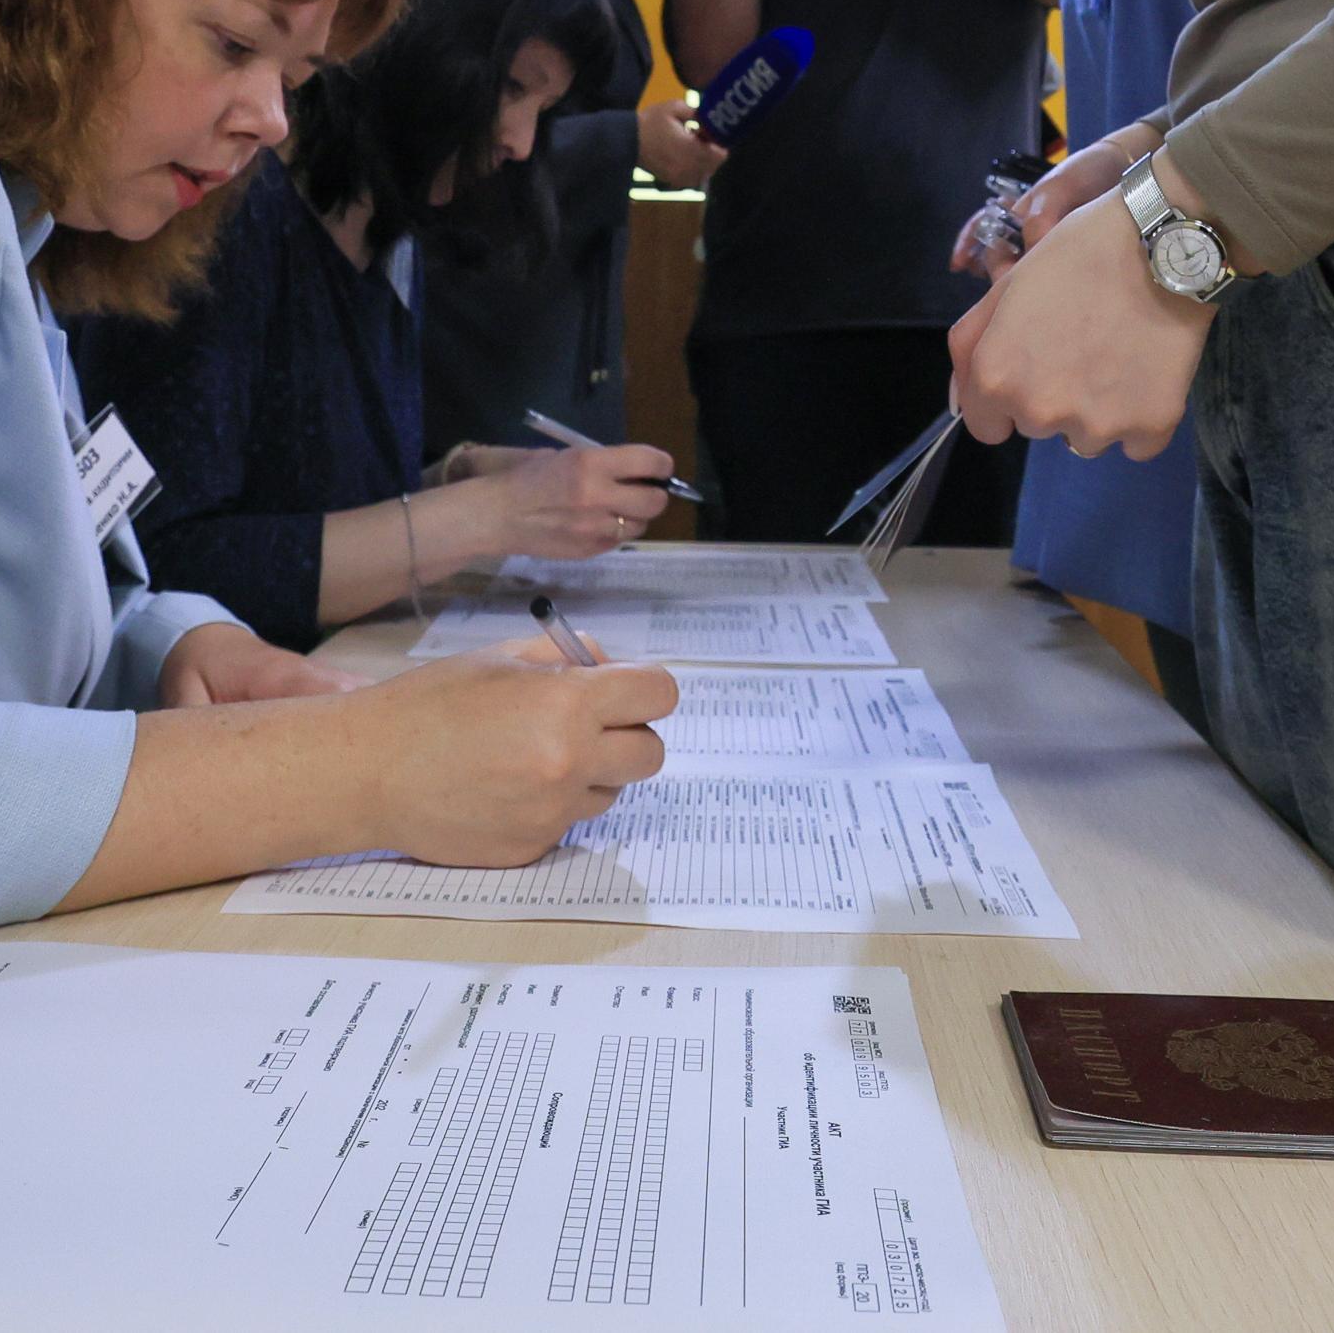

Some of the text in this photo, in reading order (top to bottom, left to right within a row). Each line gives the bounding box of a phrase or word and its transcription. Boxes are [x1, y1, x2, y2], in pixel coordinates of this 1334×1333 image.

[707, 57, 781, 131] РОССИЯ
[342, 1023, 358, 1036] ГИА
[349, 1001, 368, 1024] участника
[323, 1036, 348, 1072] подтверждаю
[743, 988, 755, 1108] Наименование образовательной организации
[1059, 1008, 1142, 1102] ПАСПОРТ
[539, 1092, 563, 1149] Сопровождающий
[777, 1106, 789, 1150] Участник ГИА
[803, 1052, 831, 1216] об идентификации личности участника ГИА
[828, 1122, 842, 1138] АКТ
[886, 1243, 910, 1309] 030725
